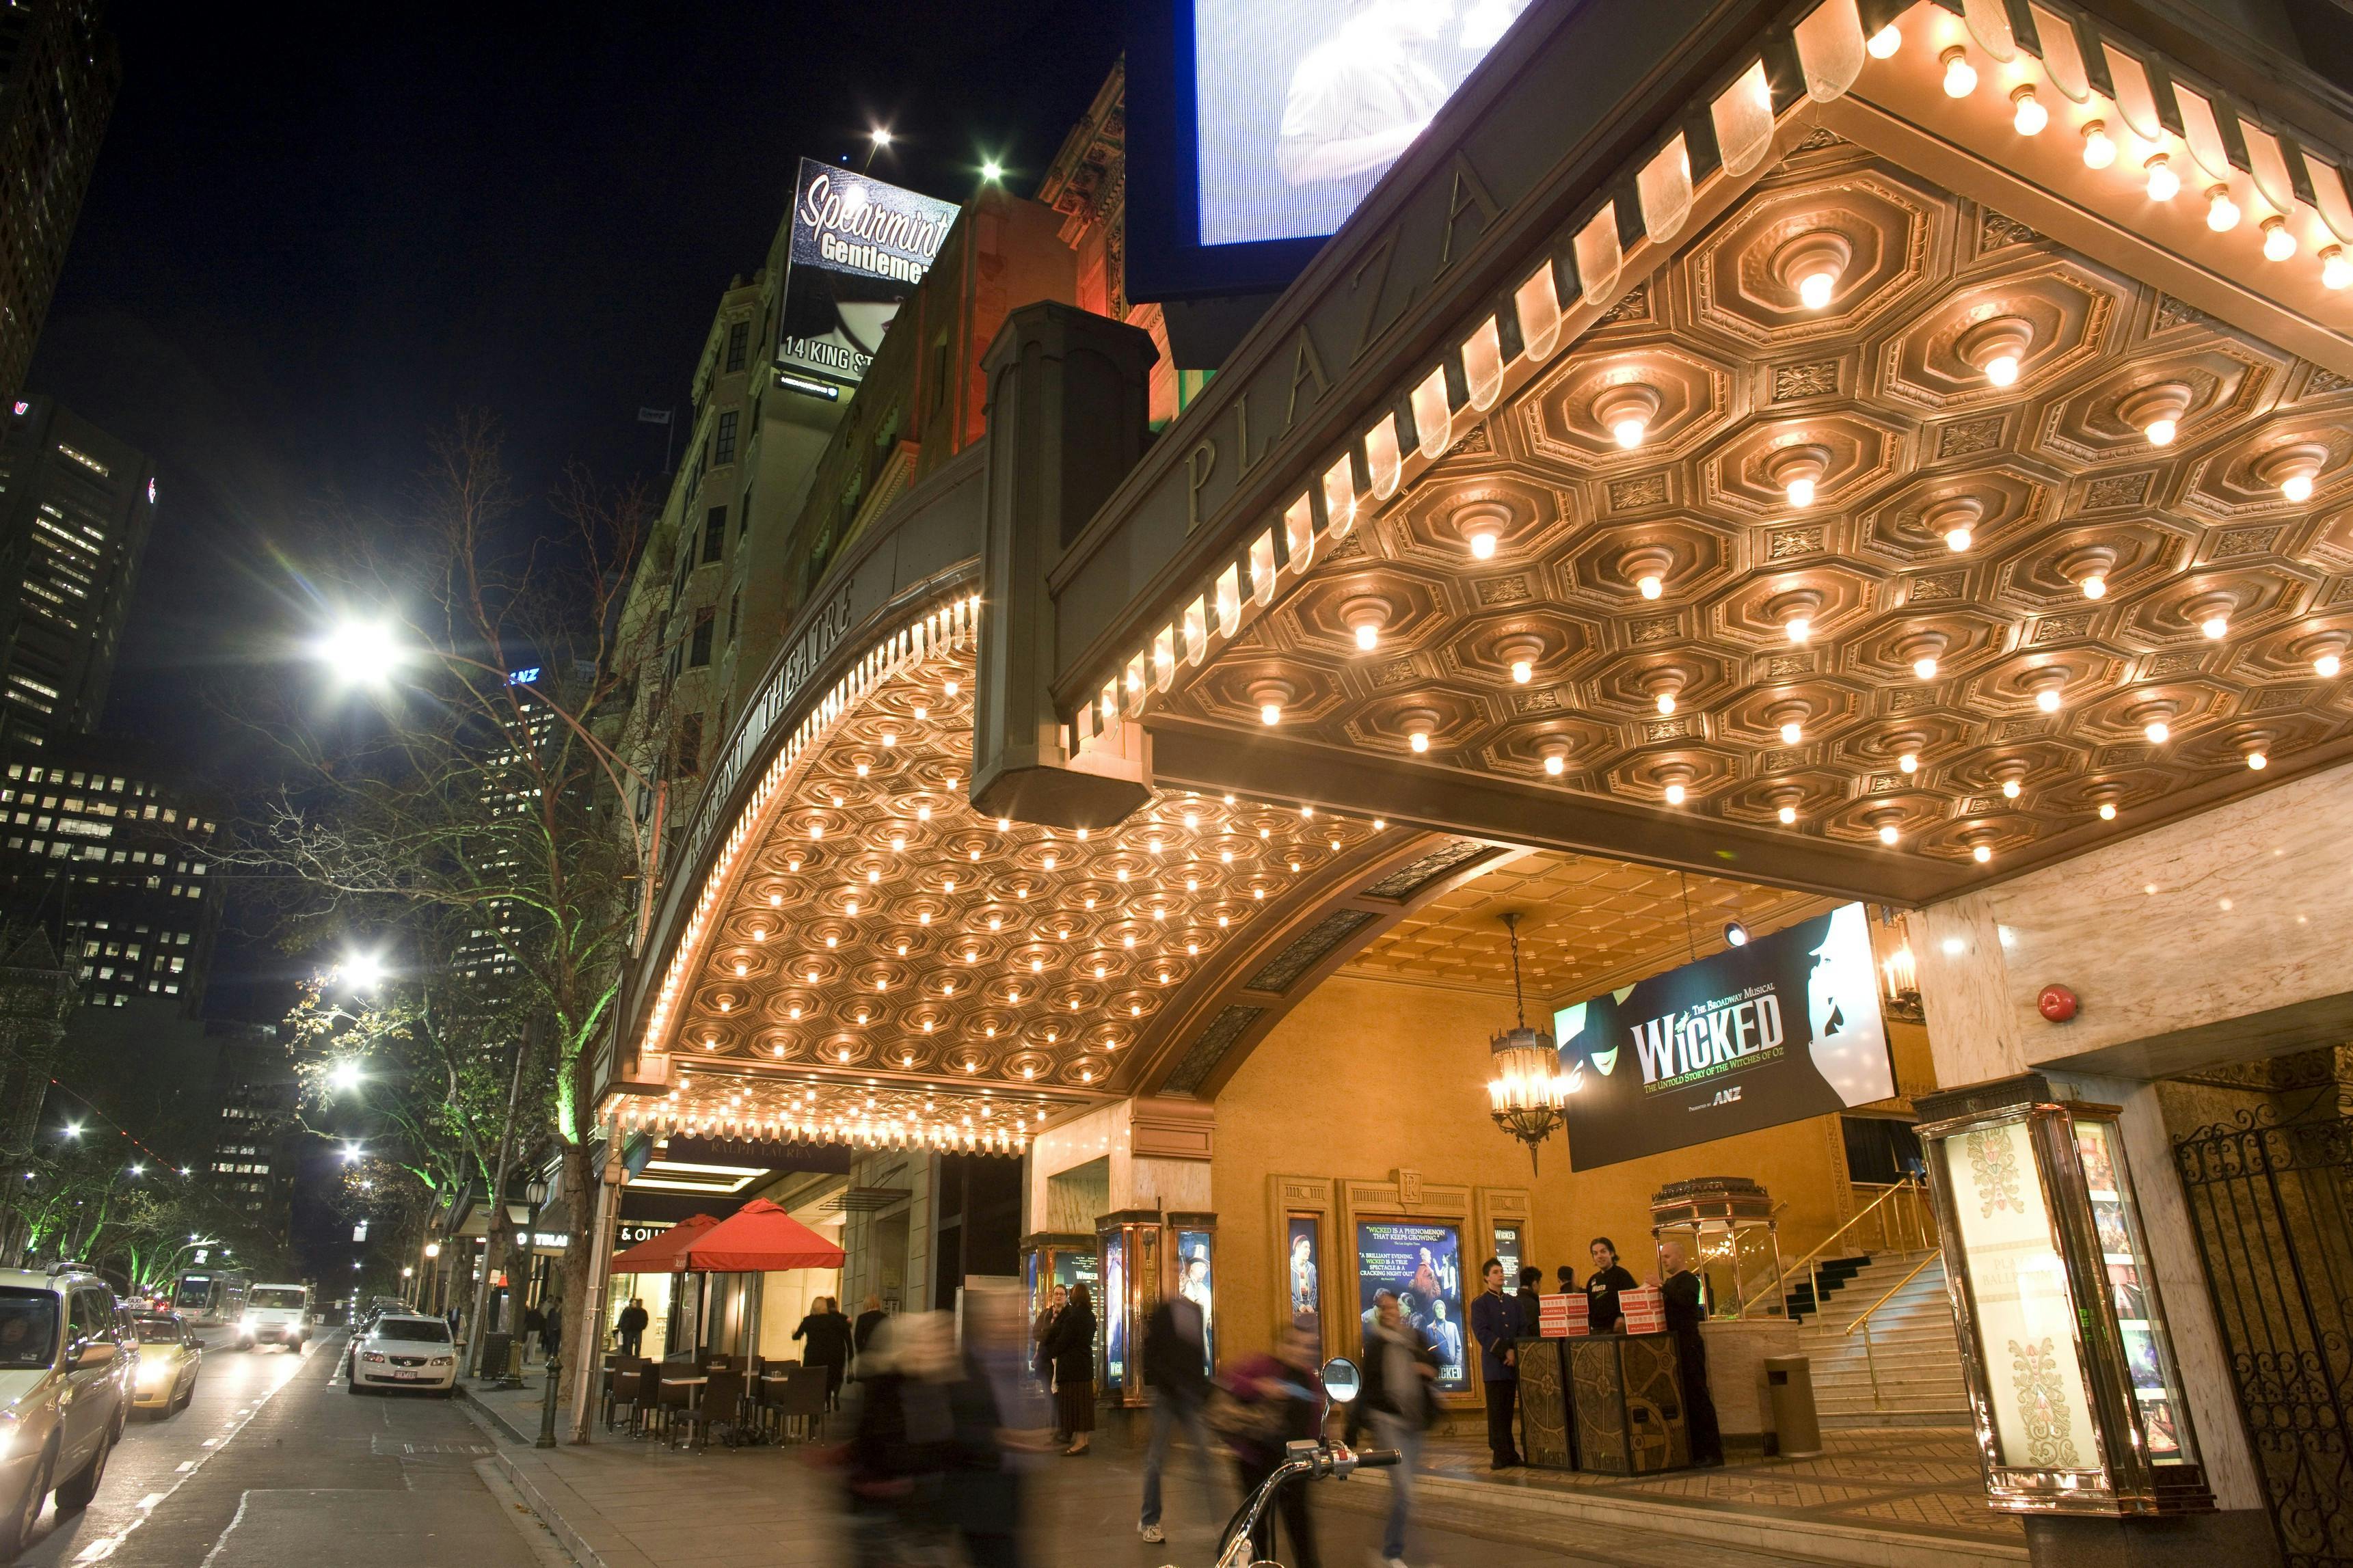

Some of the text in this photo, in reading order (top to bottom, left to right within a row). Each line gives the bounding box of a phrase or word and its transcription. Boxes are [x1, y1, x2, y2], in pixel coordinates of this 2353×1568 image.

[801, 174, 949, 258] Spearmint
[786, 336, 805, 357] 14
[809, 342, 849, 369] KING
[1185, 149, 1507, 539] PLAZA
[762, 579, 855, 733] THEATRE
[1692, 983, 1775, 1016] THE BROADWAY MUSICAL
[1643, 1083, 1657, 1094] THE
[1658, 1076, 1684, 1090] UNTOLD
[1684, 1070, 1706, 1083] STORY
[1706, 1067, 1715, 1076] OF
[1716, 1065, 1729, 1074] THE
[1730, 1055, 1761, 1070] WITCHES
[1762, 1051, 1772, 1060] OF
[1712, 1086, 1742, 1106] ANZ
[711, 1141, 811, 1159] RALPH LAUREN
[621, 1228, 632, 1241] &
